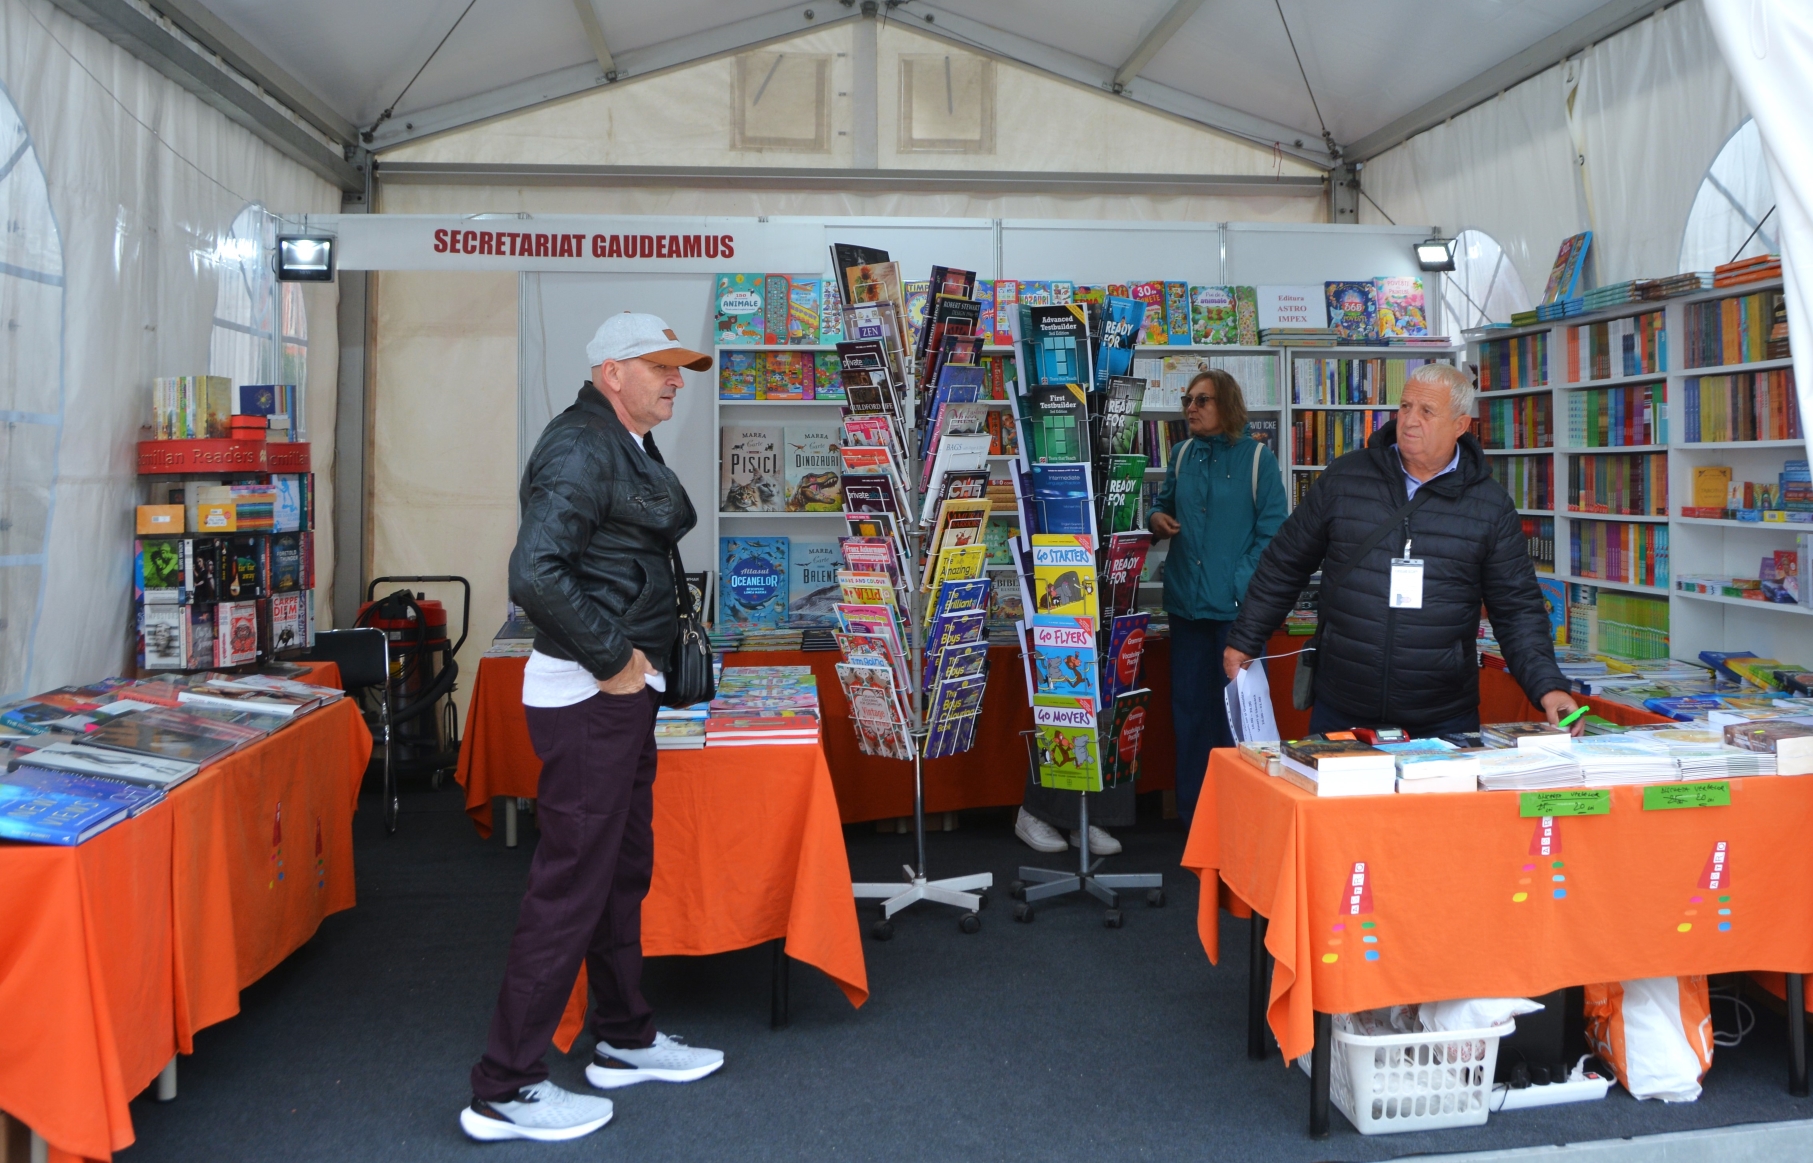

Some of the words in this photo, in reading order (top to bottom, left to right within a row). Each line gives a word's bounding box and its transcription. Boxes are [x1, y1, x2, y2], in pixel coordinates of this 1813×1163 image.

[434, 228, 586, 257] SECRETARIAT
[592, 234, 734, 258] GAUDEAMUS
[1137, 286, 1151, 296] 30
[961, 302, 980, 311] STEWART
[1344, 303, 1362, 312] 365
[862, 327, 879, 337] ZEN
[1106, 321, 1134, 336] READY
[1104, 337, 1120, 348] FOR
[1109, 400, 1136, 414] READY
[1106, 414, 1125, 427] FOR
[1248, 421, 1262, 430] AVID
[1263, 421, 1276, 430] ICKE
[192, 448, 253, 463] Readers
[796, 454, 839, 468] DINOZAURI
[732, 454, 777, 475] PISICI
[950, 480, 985, 498] CHE
[1110, 480, 1136, 492] READY
[1108, 494, 1125, 506] FOR
[947, 510, 984, 520] SAMURAI
[1037, 549, 1048, 562] GO
[1050, 549, 1089, 563] STARTERS
[940, 565, 971, 576] Amazing
[1113, 557, 1140, 572] READY
[242, 572, 255, 582] away
[731, 575, 778, 587] OCEANELOR
[804, 569, 839, 584] BALENE
[1110, 572, 1127, 584] FOR
[854, 587, 883, 600] Wild
[273, 596, 298, 606] CARPE
[945, 598, 972, 610] Brilliant
[273, 605, 297, 614] DIEM
[1039, 630, 1052, 642] GO
[1055, 630, 1087, 645] FLYERS
[862, 706, 885, 718] Vintage
[1038, 709, 1050, 722] GO
[1053, 711, 1090, 725] MOVERS
[937, 724, 951, 732] Book
[1574, 802, 1585, 811] 20
[1541, 816, 1553, 855] ASTR
[1710, 841, 1726, 889] ASTRO
[1350, 862, 1365, 915] ASTRO
